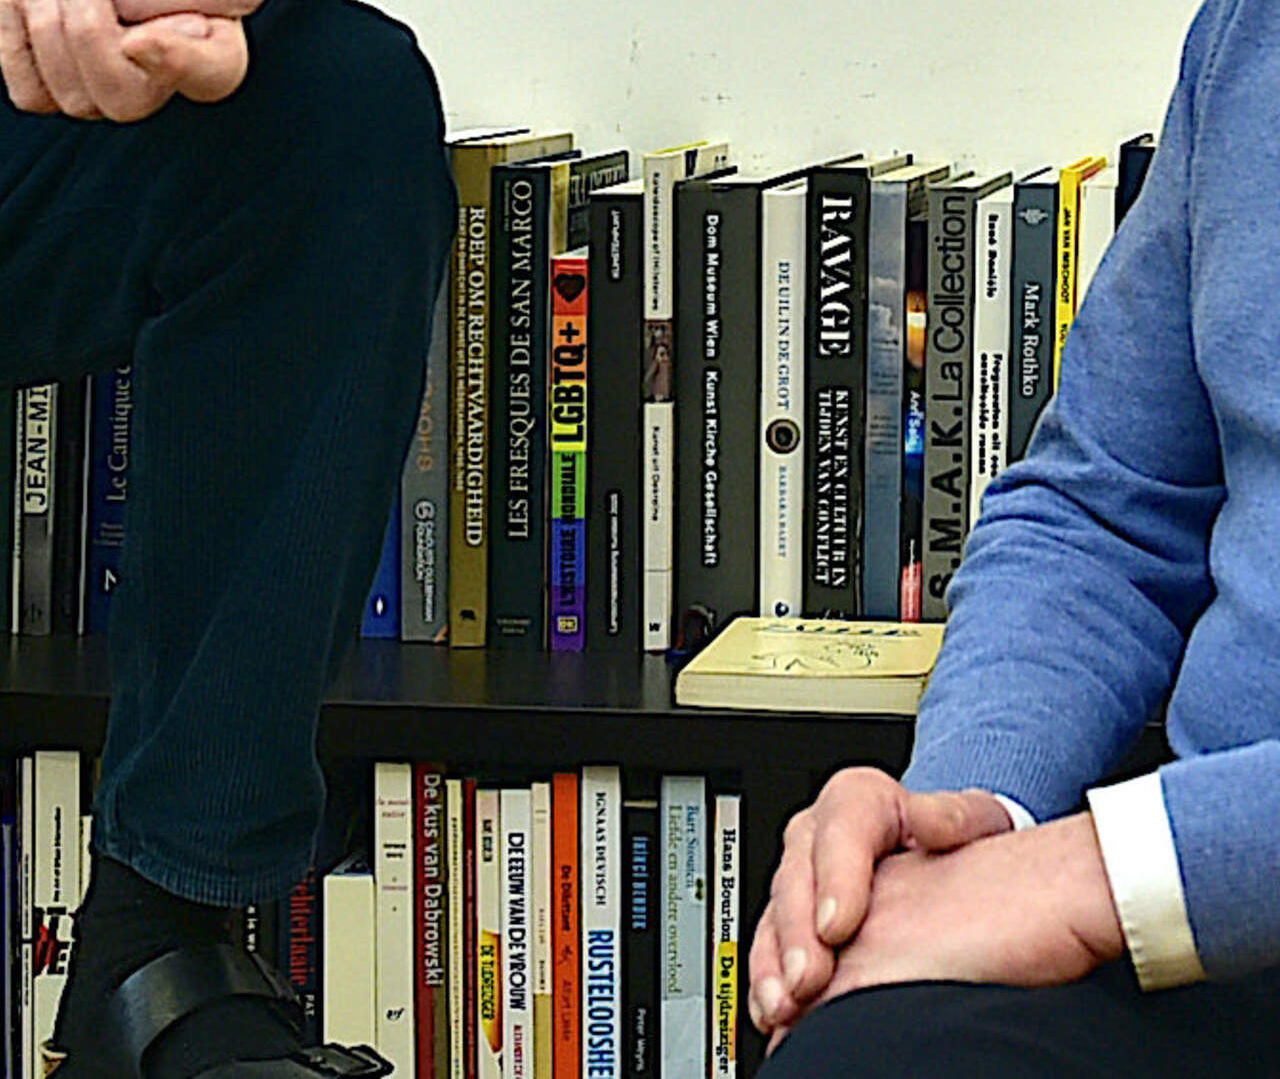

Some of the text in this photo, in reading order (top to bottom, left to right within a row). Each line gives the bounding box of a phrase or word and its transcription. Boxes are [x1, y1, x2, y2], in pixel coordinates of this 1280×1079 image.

[775, 262, 792, 411] DE UIL IN DE GROT
[820, 195, 854, 356] RAVAGE
[931, 195, 966, 354] Collection
[1021, 282, 1041, 397] Mark Rothko
[106, 378, 134, 472] Cantique
[466, 206, 487, 546] ROEP OM RECHTVAARDIGHEID
[508, 180, 535, 538] LES FRESQUES DE SAN MARCO
[553, 322, 584, 442] LGBTQ+
[703, 214, 720, 566] Dom Museum Wien Kunst Kirche Gesellschaft
[931, 361, 962, 402] La
[25, 388, 49, 507] JEAN-MI
[814, 389, 834, 584] TIJDEN VAN CONFLICT
[832, 388, 850, 587] KUNST EN CULTUUR IN
[422, 773, 444, 986] De kus van Dabrowski
[595, 792, 607, 906] IGNAAS DEVISCH
[667, 804, 683, 994] Liefde en andere overvloed
[685, 805, 700, 833] Bart
[508, 832, 526, 1011] DE EEUW VAN DE VROUW
[716, 828, 736, 1074] Hans Bourlon De tijdreiziger
[588, 930, 614, 1079] RUSTELOOSHE
